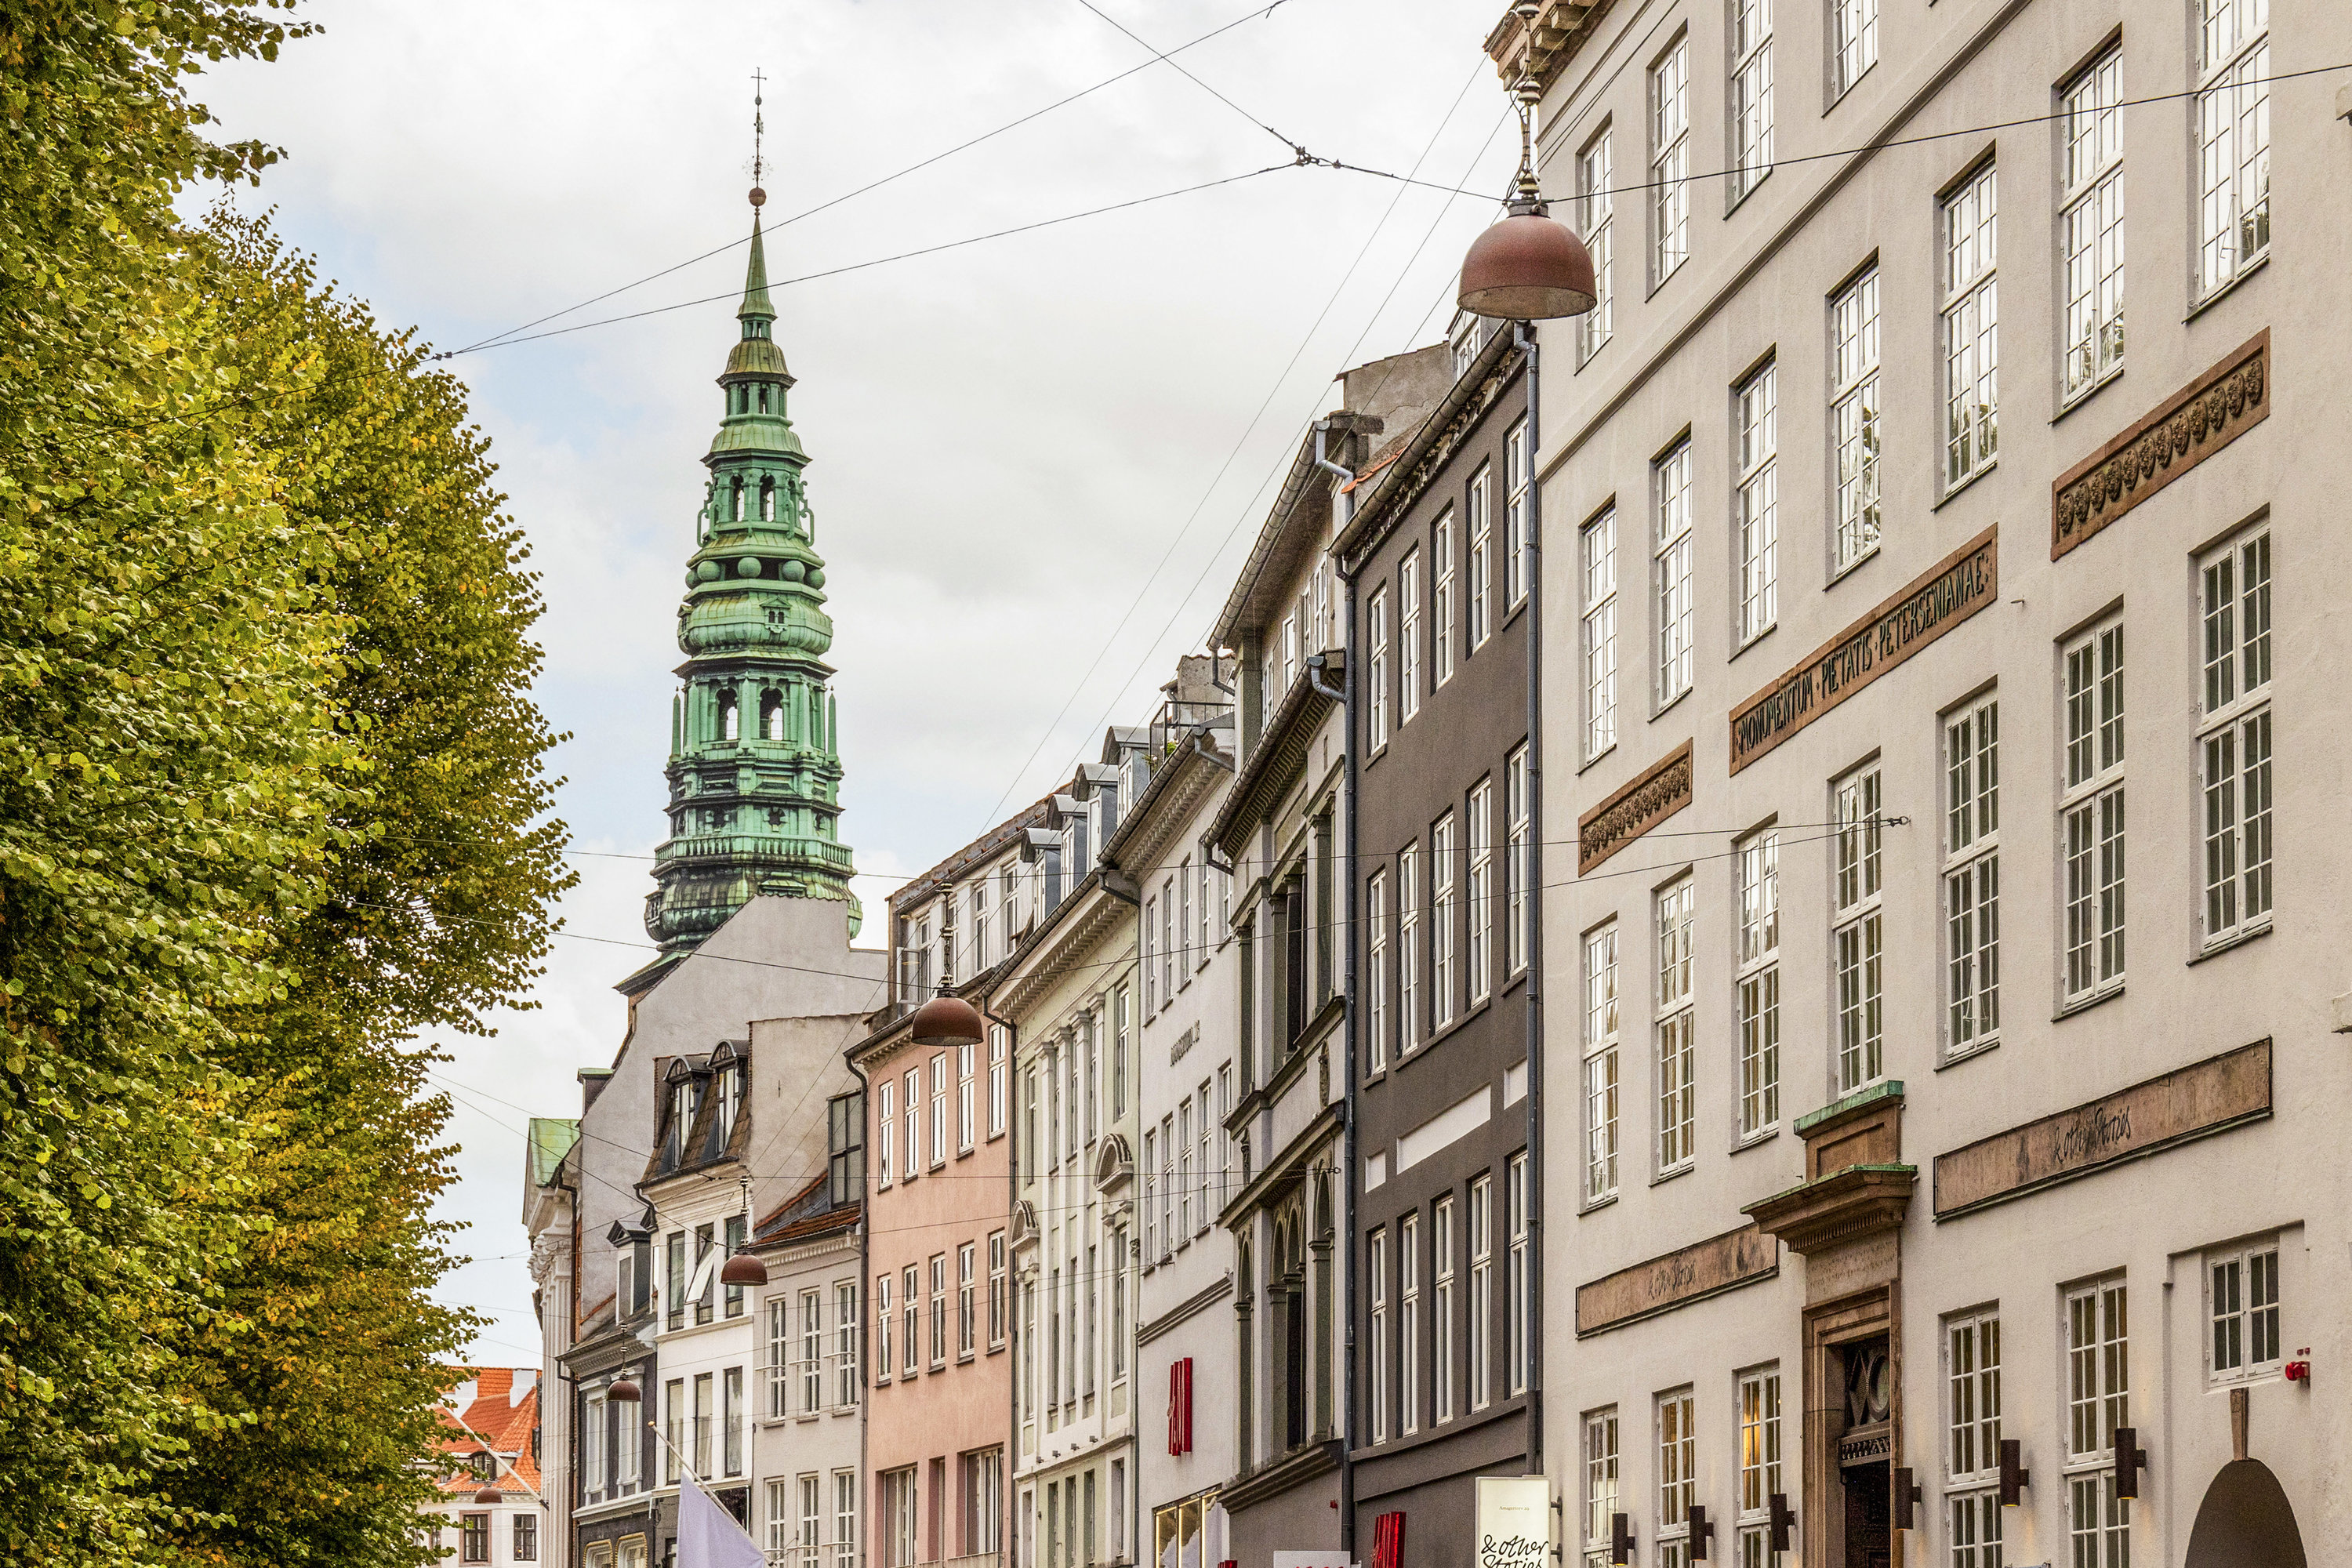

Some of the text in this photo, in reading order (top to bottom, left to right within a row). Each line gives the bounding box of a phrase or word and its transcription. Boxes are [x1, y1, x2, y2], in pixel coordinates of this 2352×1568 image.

[1737, 670, 1814, 755] MONUMENTUM
[1820, 630, 1873, 699] PIETATIS
[1481, 1534, 1549, 1558] & other
